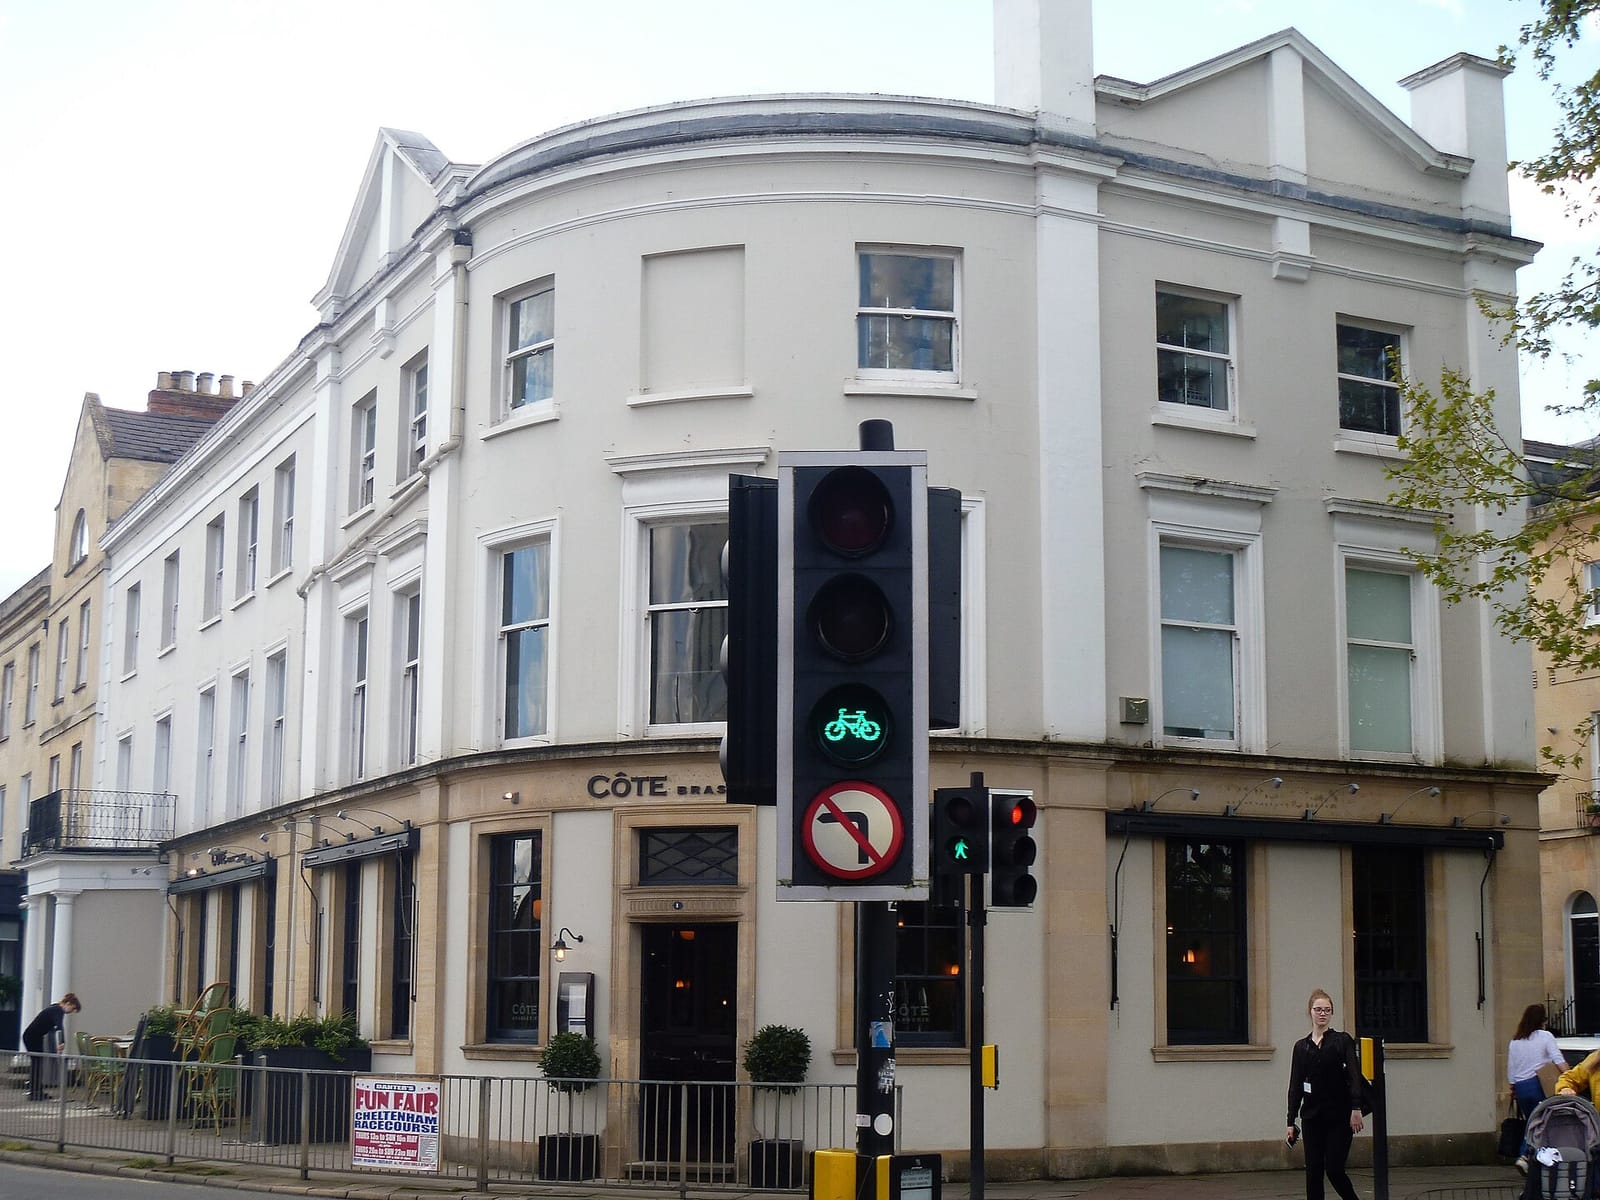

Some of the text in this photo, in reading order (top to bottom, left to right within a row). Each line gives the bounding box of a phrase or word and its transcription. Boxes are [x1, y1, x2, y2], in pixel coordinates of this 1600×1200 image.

[587, 771, 727, 799] CÔTE BRAS
[898, 1003, 929, 1017] ÔTE
[355, 1088, 439, 1115] FUN FAIR
[355, 1110, 438, 1125] CHELTENHAM
[354, 1120, 438, 1134] RACECOURSE
